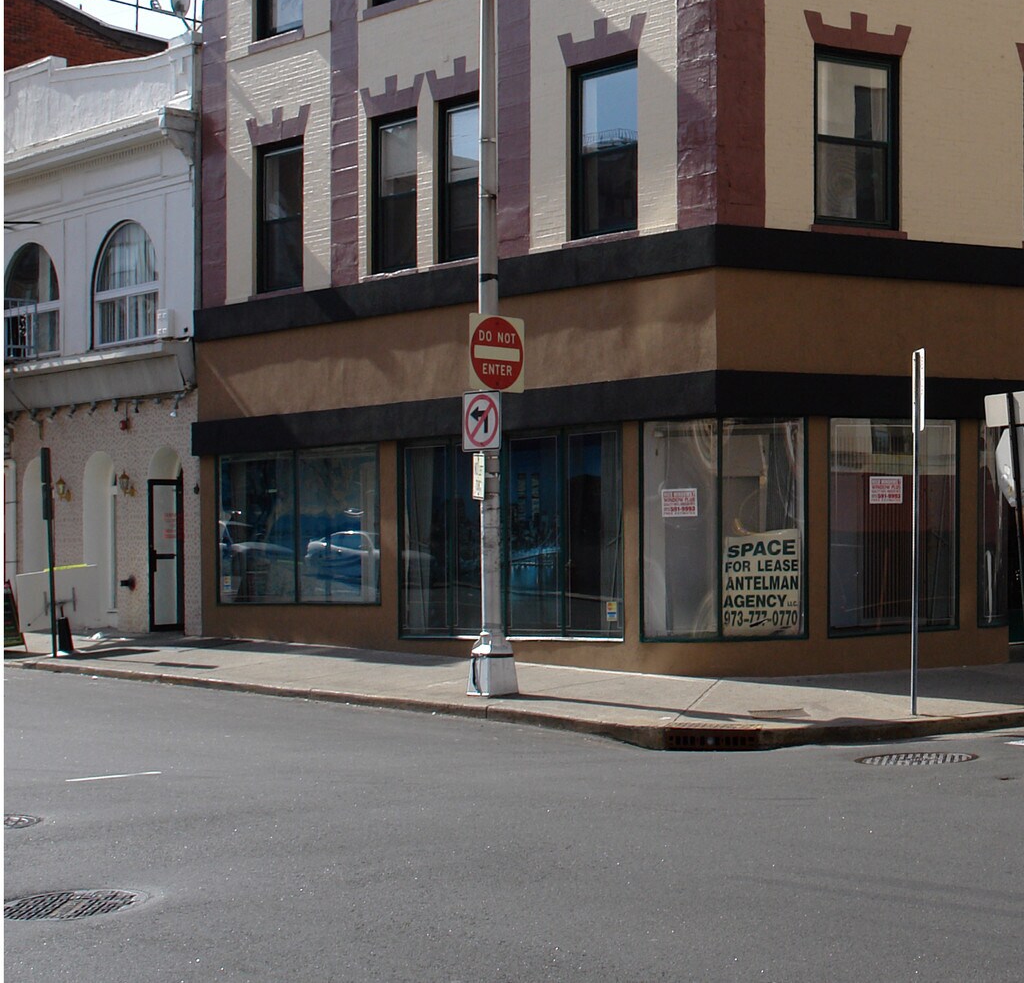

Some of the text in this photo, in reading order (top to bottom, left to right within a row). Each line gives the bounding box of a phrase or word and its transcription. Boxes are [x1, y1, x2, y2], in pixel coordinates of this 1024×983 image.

[478, 329, 516, 345] DO NOT
[482, 363, 512, 376] ENTER
[727, 539, 796, 558] SPACE
[725, 559, 799, 573] FOR LEASE
[725, 575, 799, 591] ANTELMAN
[723, 594, 787, 608] AGENCY
[724, 610, 799, 627] 973-777-0770
